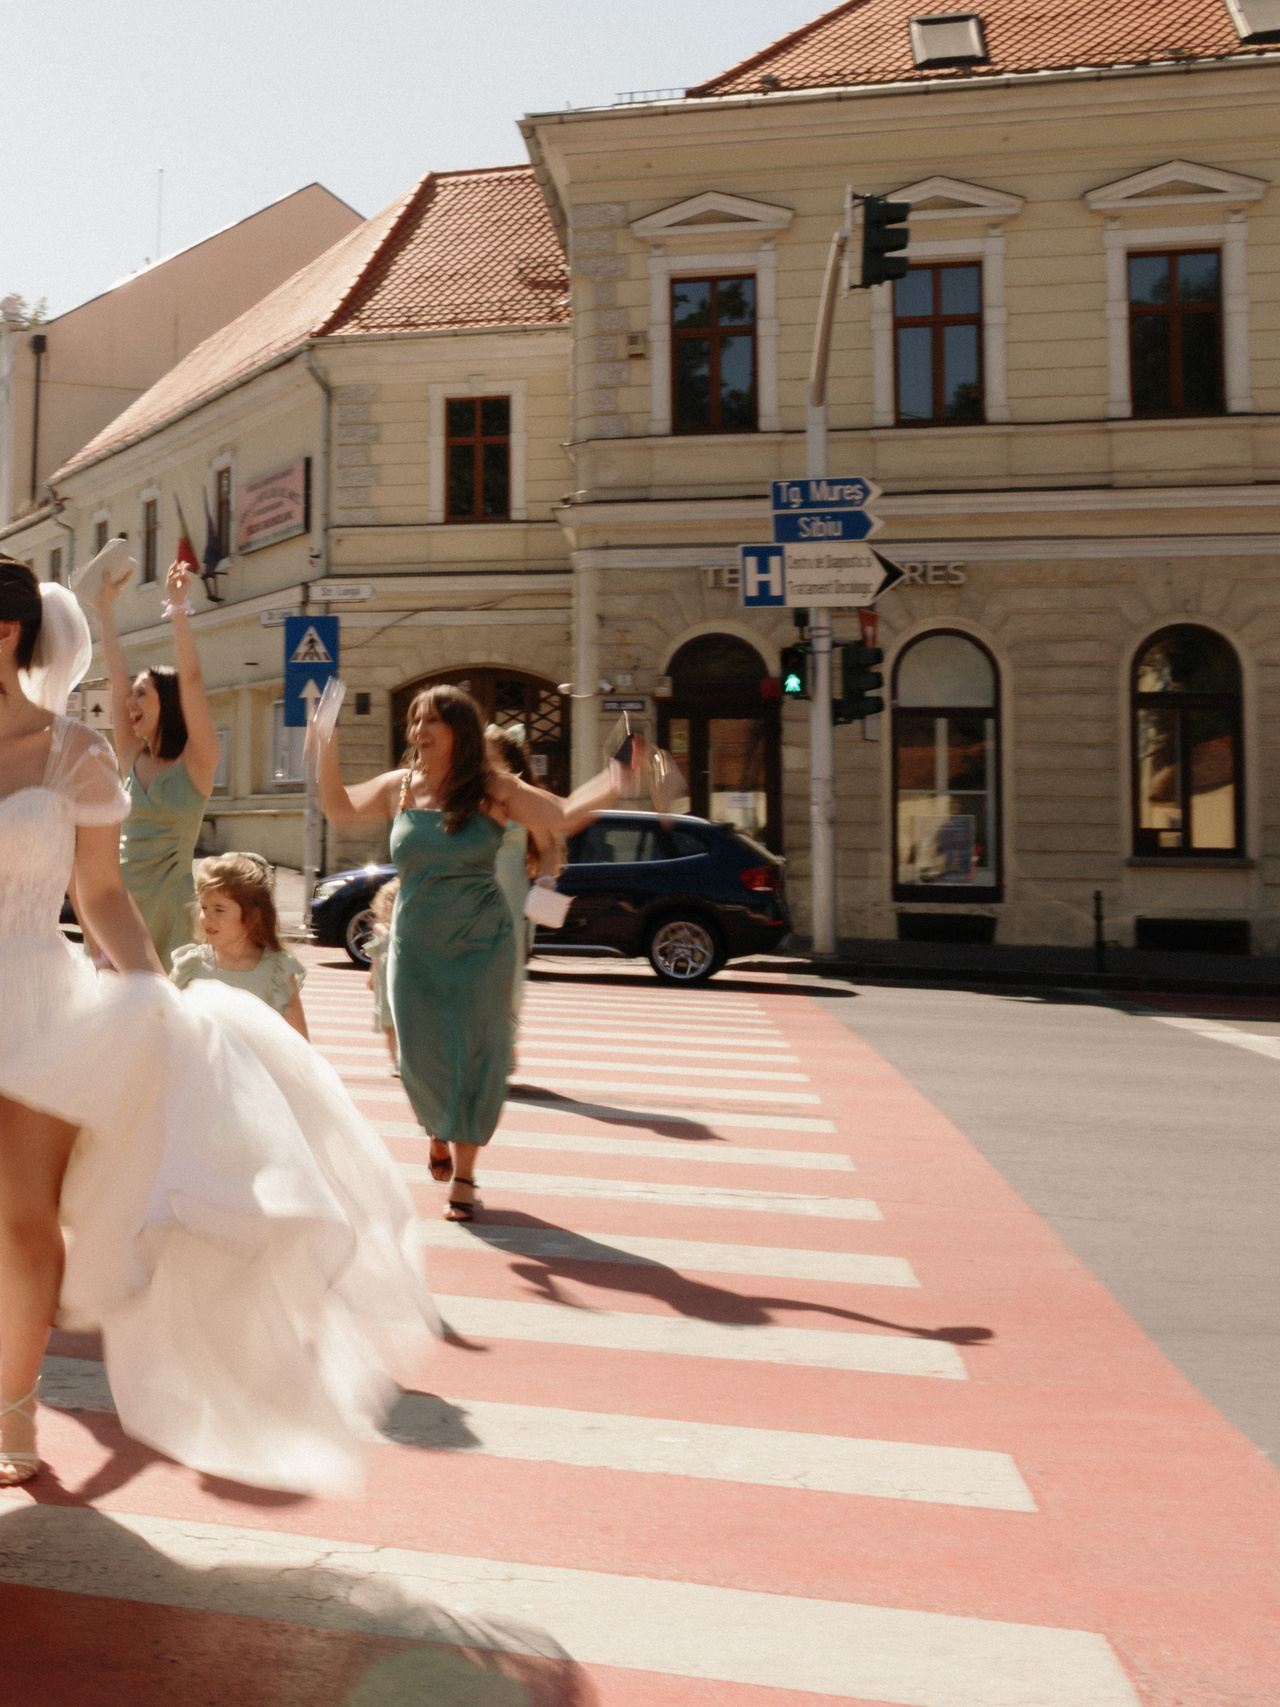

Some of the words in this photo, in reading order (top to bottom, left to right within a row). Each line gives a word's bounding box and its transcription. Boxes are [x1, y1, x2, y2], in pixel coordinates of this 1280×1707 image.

[797, 516, 843, 537] Sibiu
[744, 556, 782, 597] H
[904, 561, 967, 585] RES
